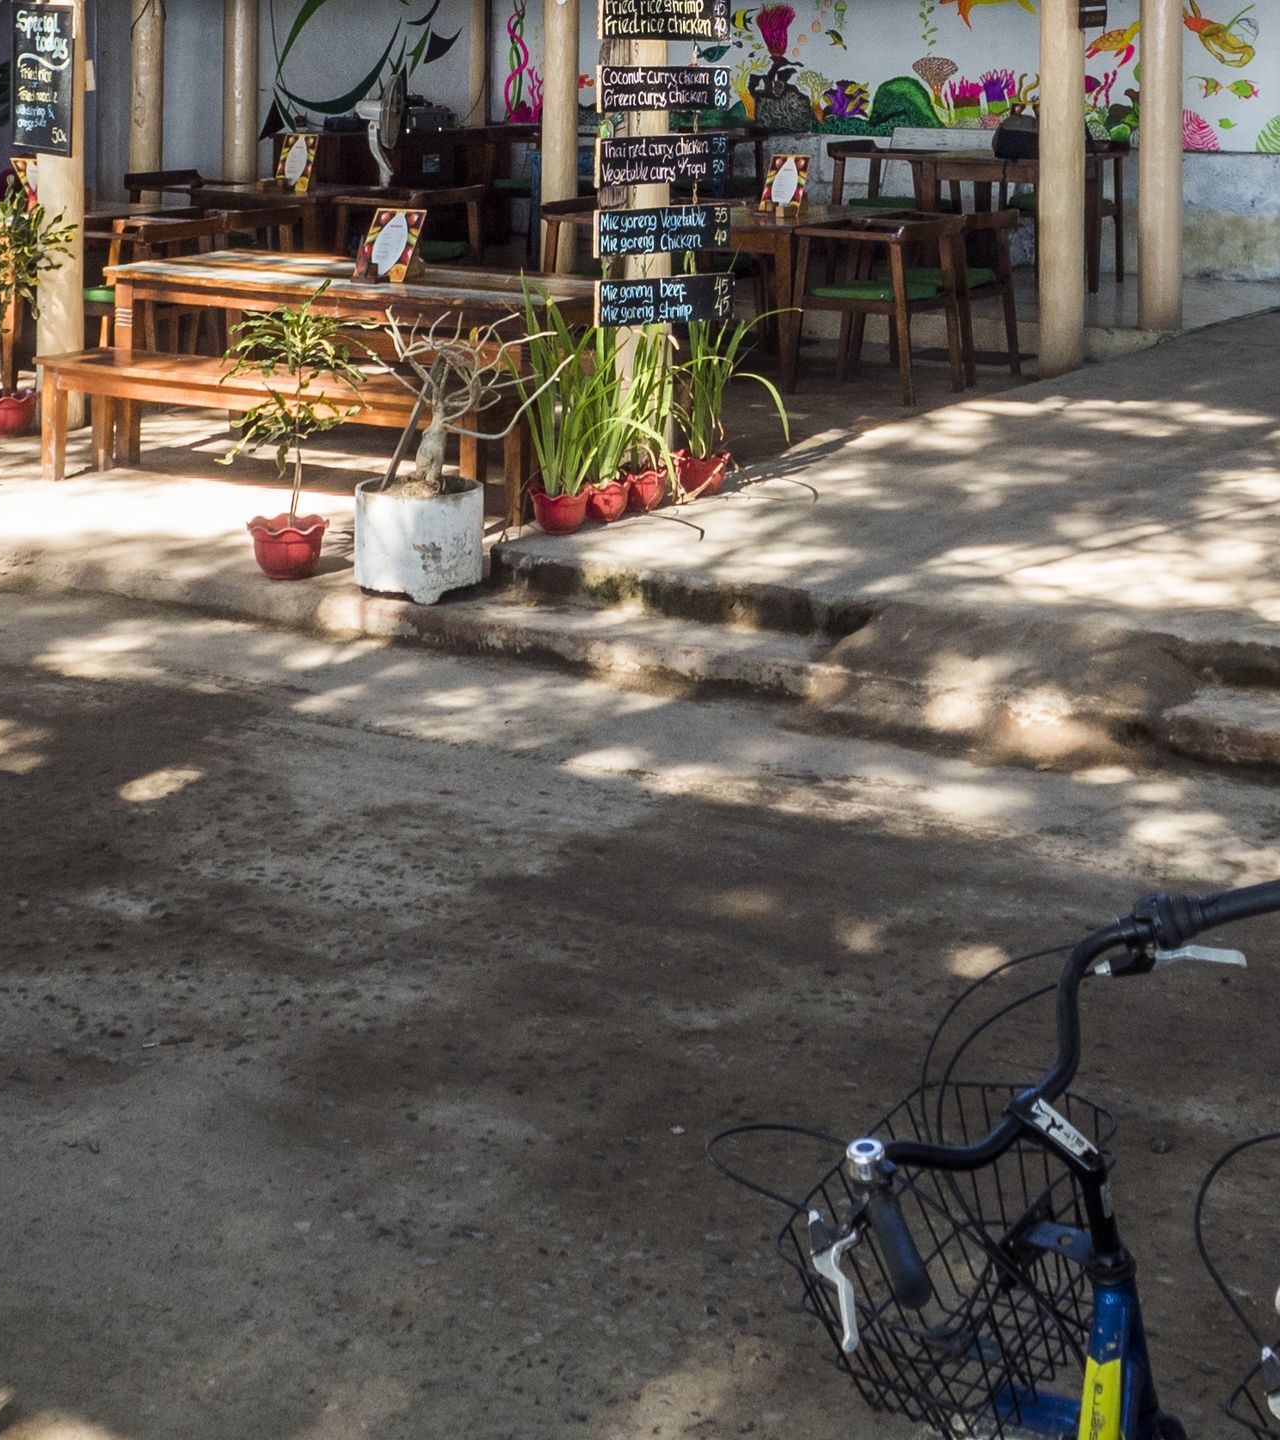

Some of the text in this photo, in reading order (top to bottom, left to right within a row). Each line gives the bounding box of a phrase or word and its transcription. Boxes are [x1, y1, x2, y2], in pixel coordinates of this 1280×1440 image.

[16, 10, 61, 39] Special
[604, 12, 712, 37] Fried rice chicken
[35, 32, 68, 59] today
[602, 68, 646, 86] Coconut
[646, 71, 677, 90] curry
[713, 69, 727, 87] 60
[604, 89, 637, 107] Green
[637, 90, 667, 109] curry
[714, 88, 727, 106] 60
[601, 136, 709, 163] Thai red curry chicken
[601, 160, 649, 186] Vegetable
[650, 164, 676, 183] curry
[712, 159, 725, 174] 50
[600, 205, 707, 234] Mie goreng Vegetable
[714, 207, 728, 223] 35
[600, 232, 702, 254] Mie goreng Chicken
[714, 227, 727, 246] 40
[601, 277, 687, 305] Mie goreng beef
[714, 276, 729, 295] 45
[601, 303, 618, 322] Mie
[618, 303, 654, 325] goreng
[714, 295, 730, 317] 45
